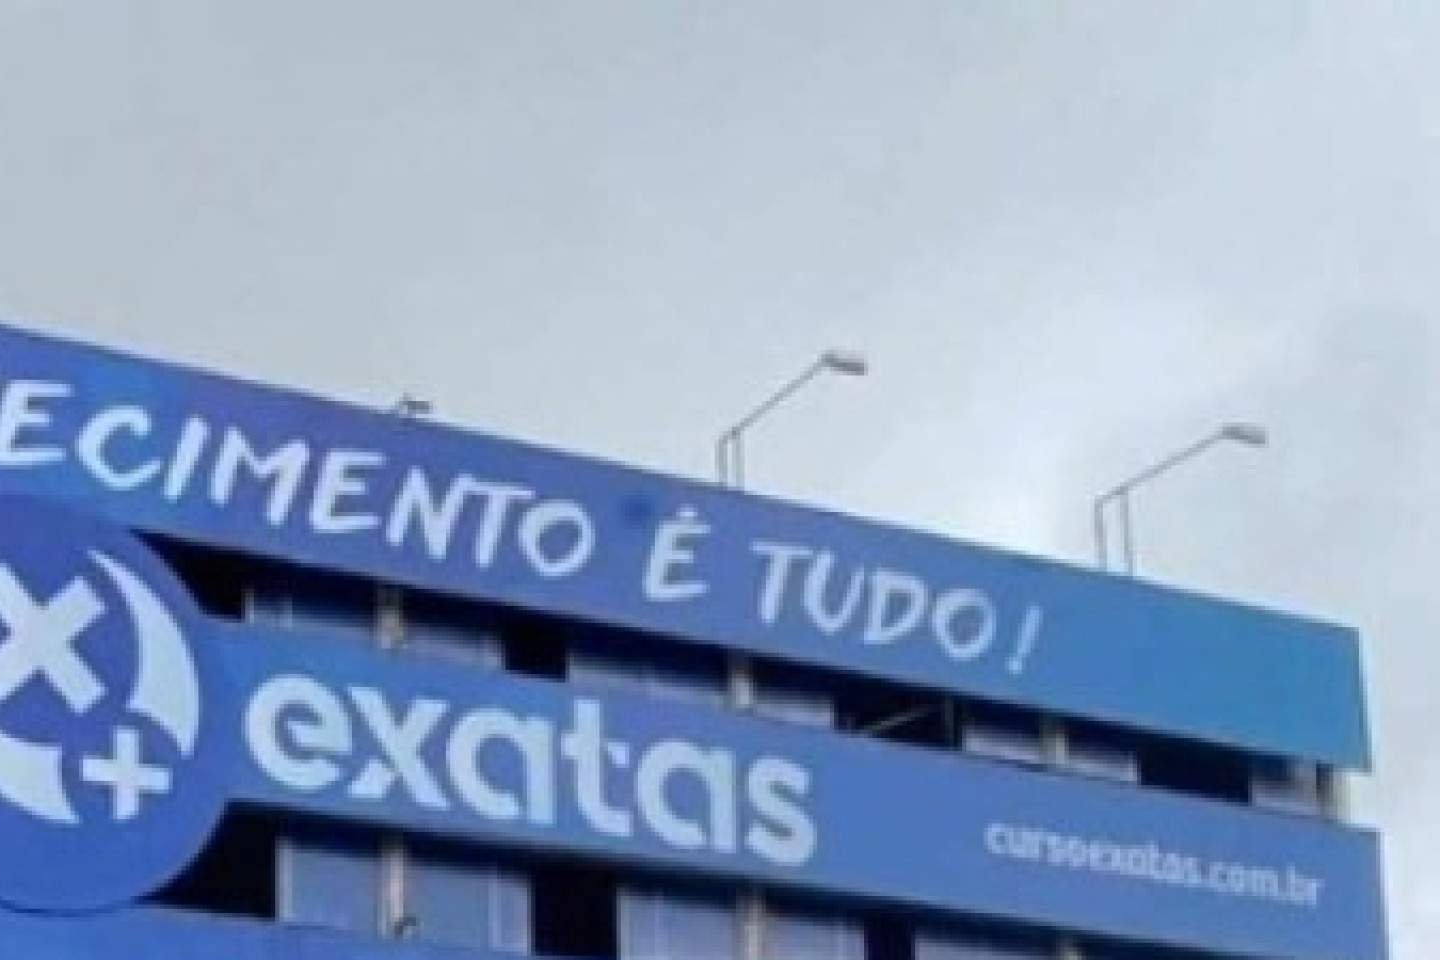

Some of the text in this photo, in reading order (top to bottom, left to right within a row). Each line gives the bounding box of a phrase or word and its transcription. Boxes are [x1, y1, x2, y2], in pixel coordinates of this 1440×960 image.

[642, 505, 711, 600] É
[244, 673, 816, 868] exatas
[984, 822, 1325, 908] cursoexatas.com.br
